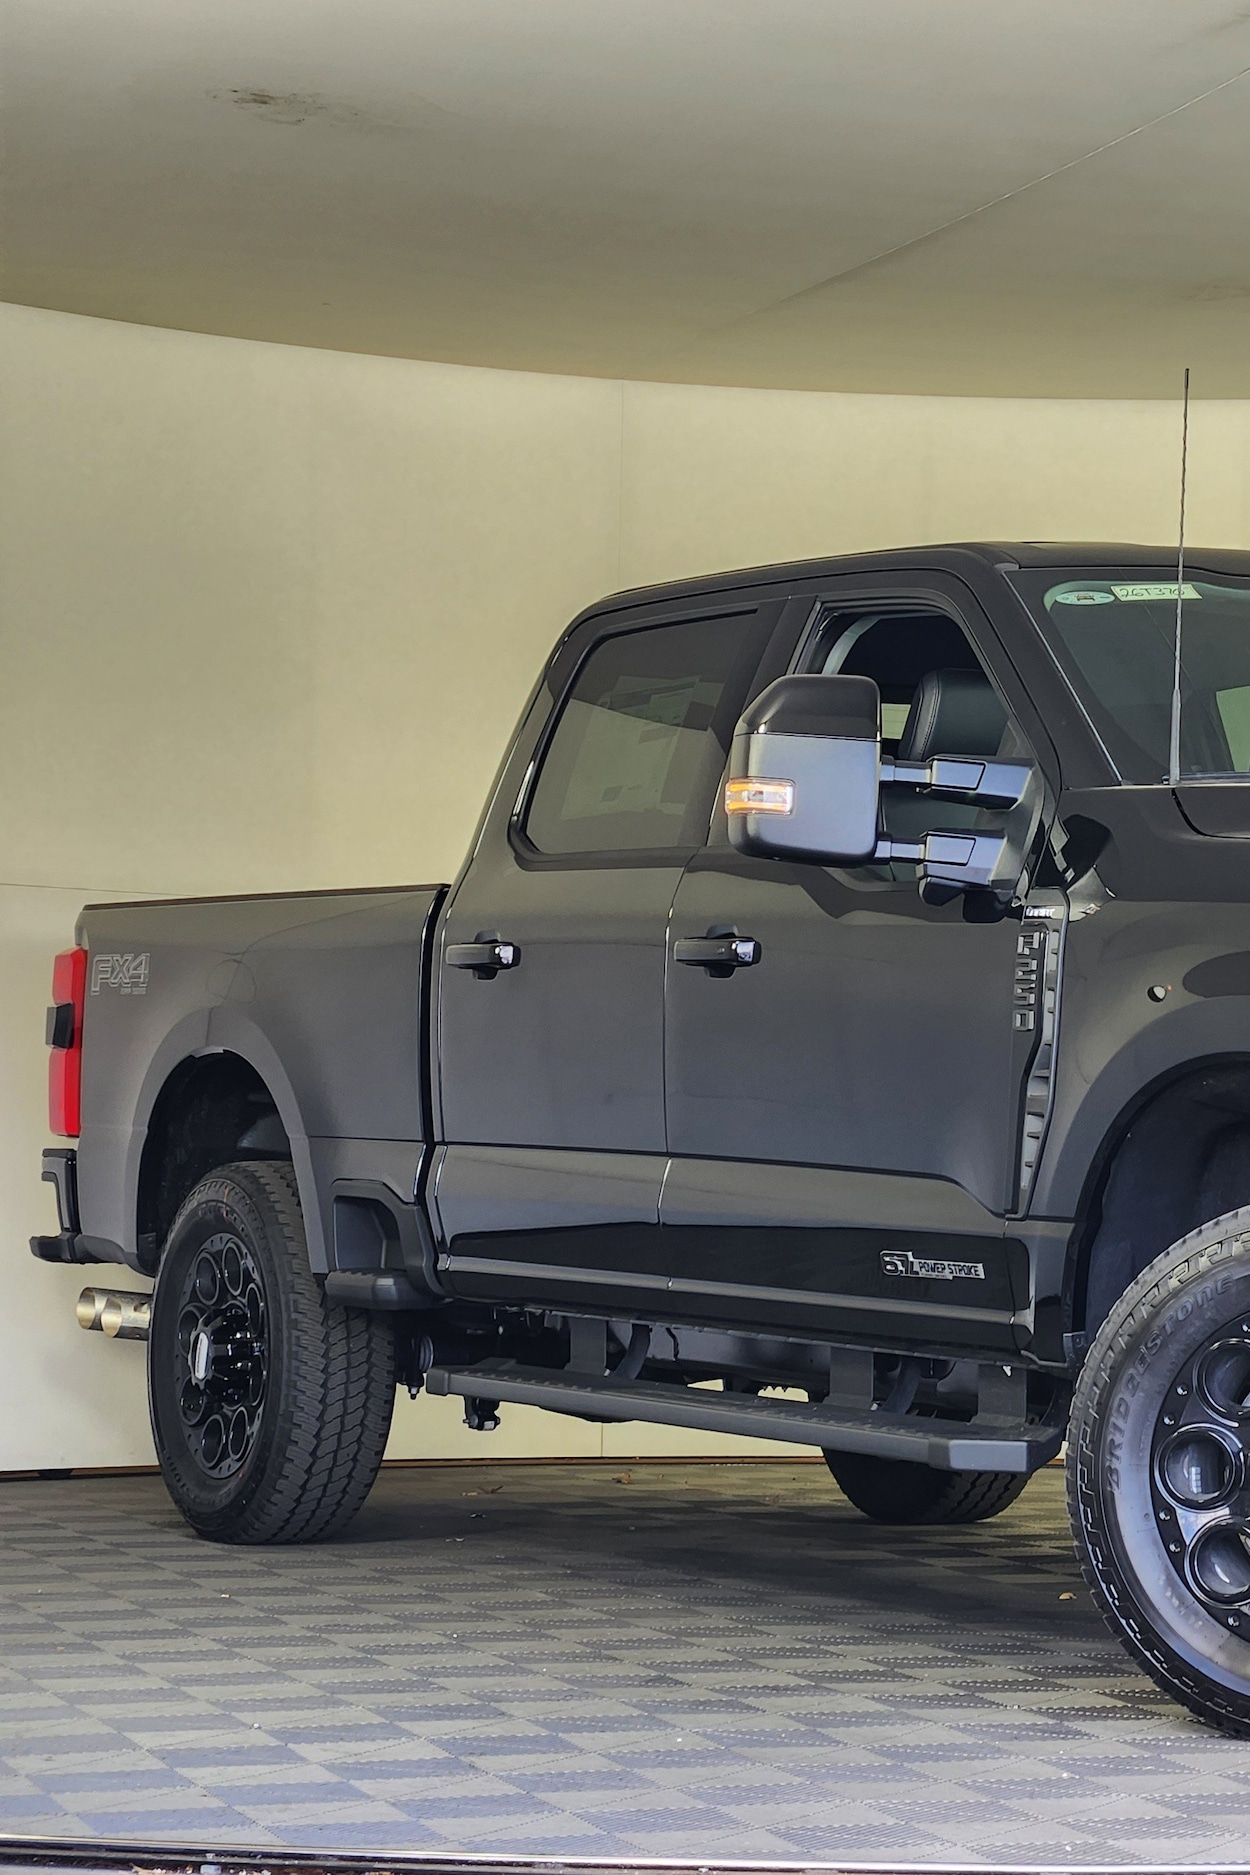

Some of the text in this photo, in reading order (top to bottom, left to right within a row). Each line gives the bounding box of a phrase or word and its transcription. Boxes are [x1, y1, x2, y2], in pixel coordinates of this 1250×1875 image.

[91, 953, 150, 996] FX4
[919, 1261, 947, 1275] POWER
[947, 1263, 980, 1277] STROKE
[1104, 1270, 1236, 1495] BRIDGESTONE
